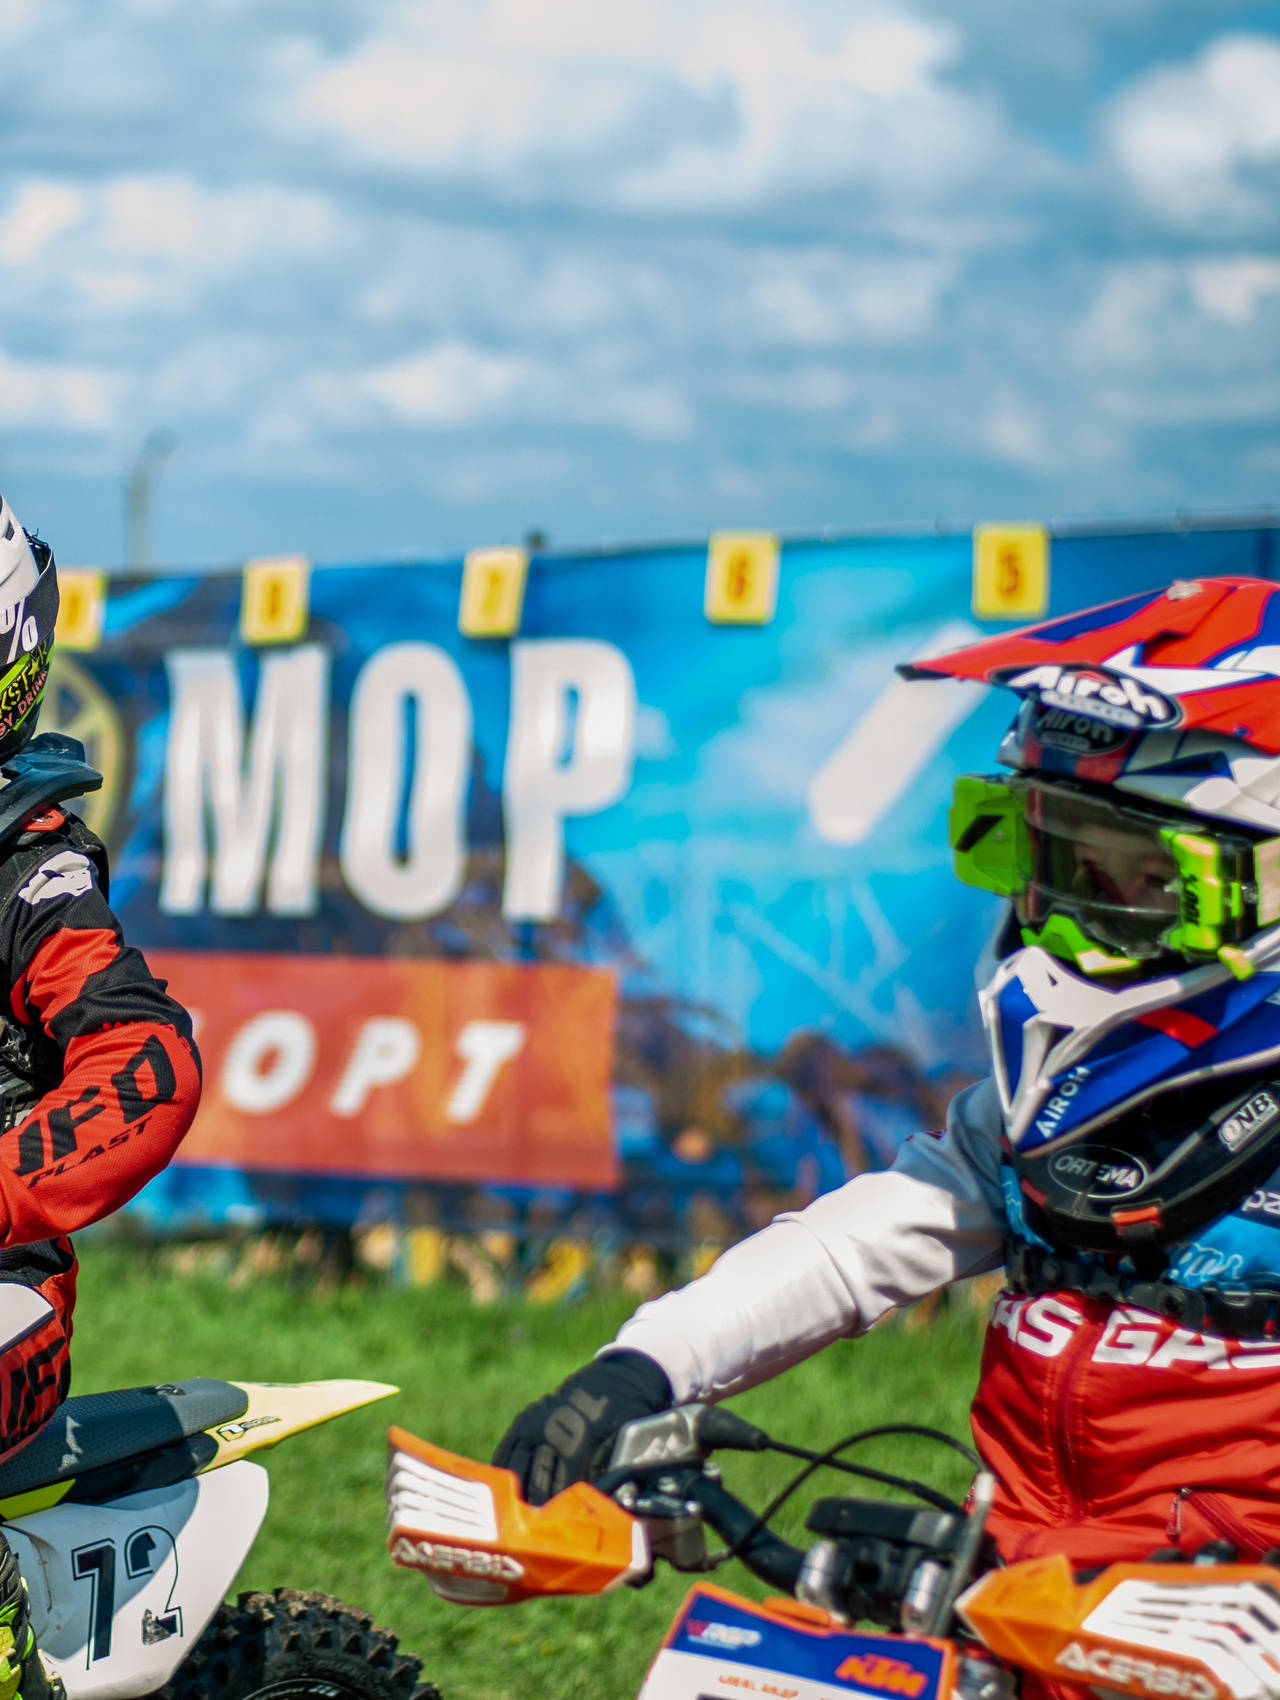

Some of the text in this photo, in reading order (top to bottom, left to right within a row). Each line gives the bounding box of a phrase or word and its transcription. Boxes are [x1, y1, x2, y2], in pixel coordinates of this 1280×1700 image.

[1035, 1066, 1091, 1138] AIROH
[28, 1116, 153, 1188] PLAST
[1054, 1154, 1137, 1188] ORTEMA
[836, 1654, 929, 1698] KTM
[1055, 1642, 1218, 1700] ACERBIS
